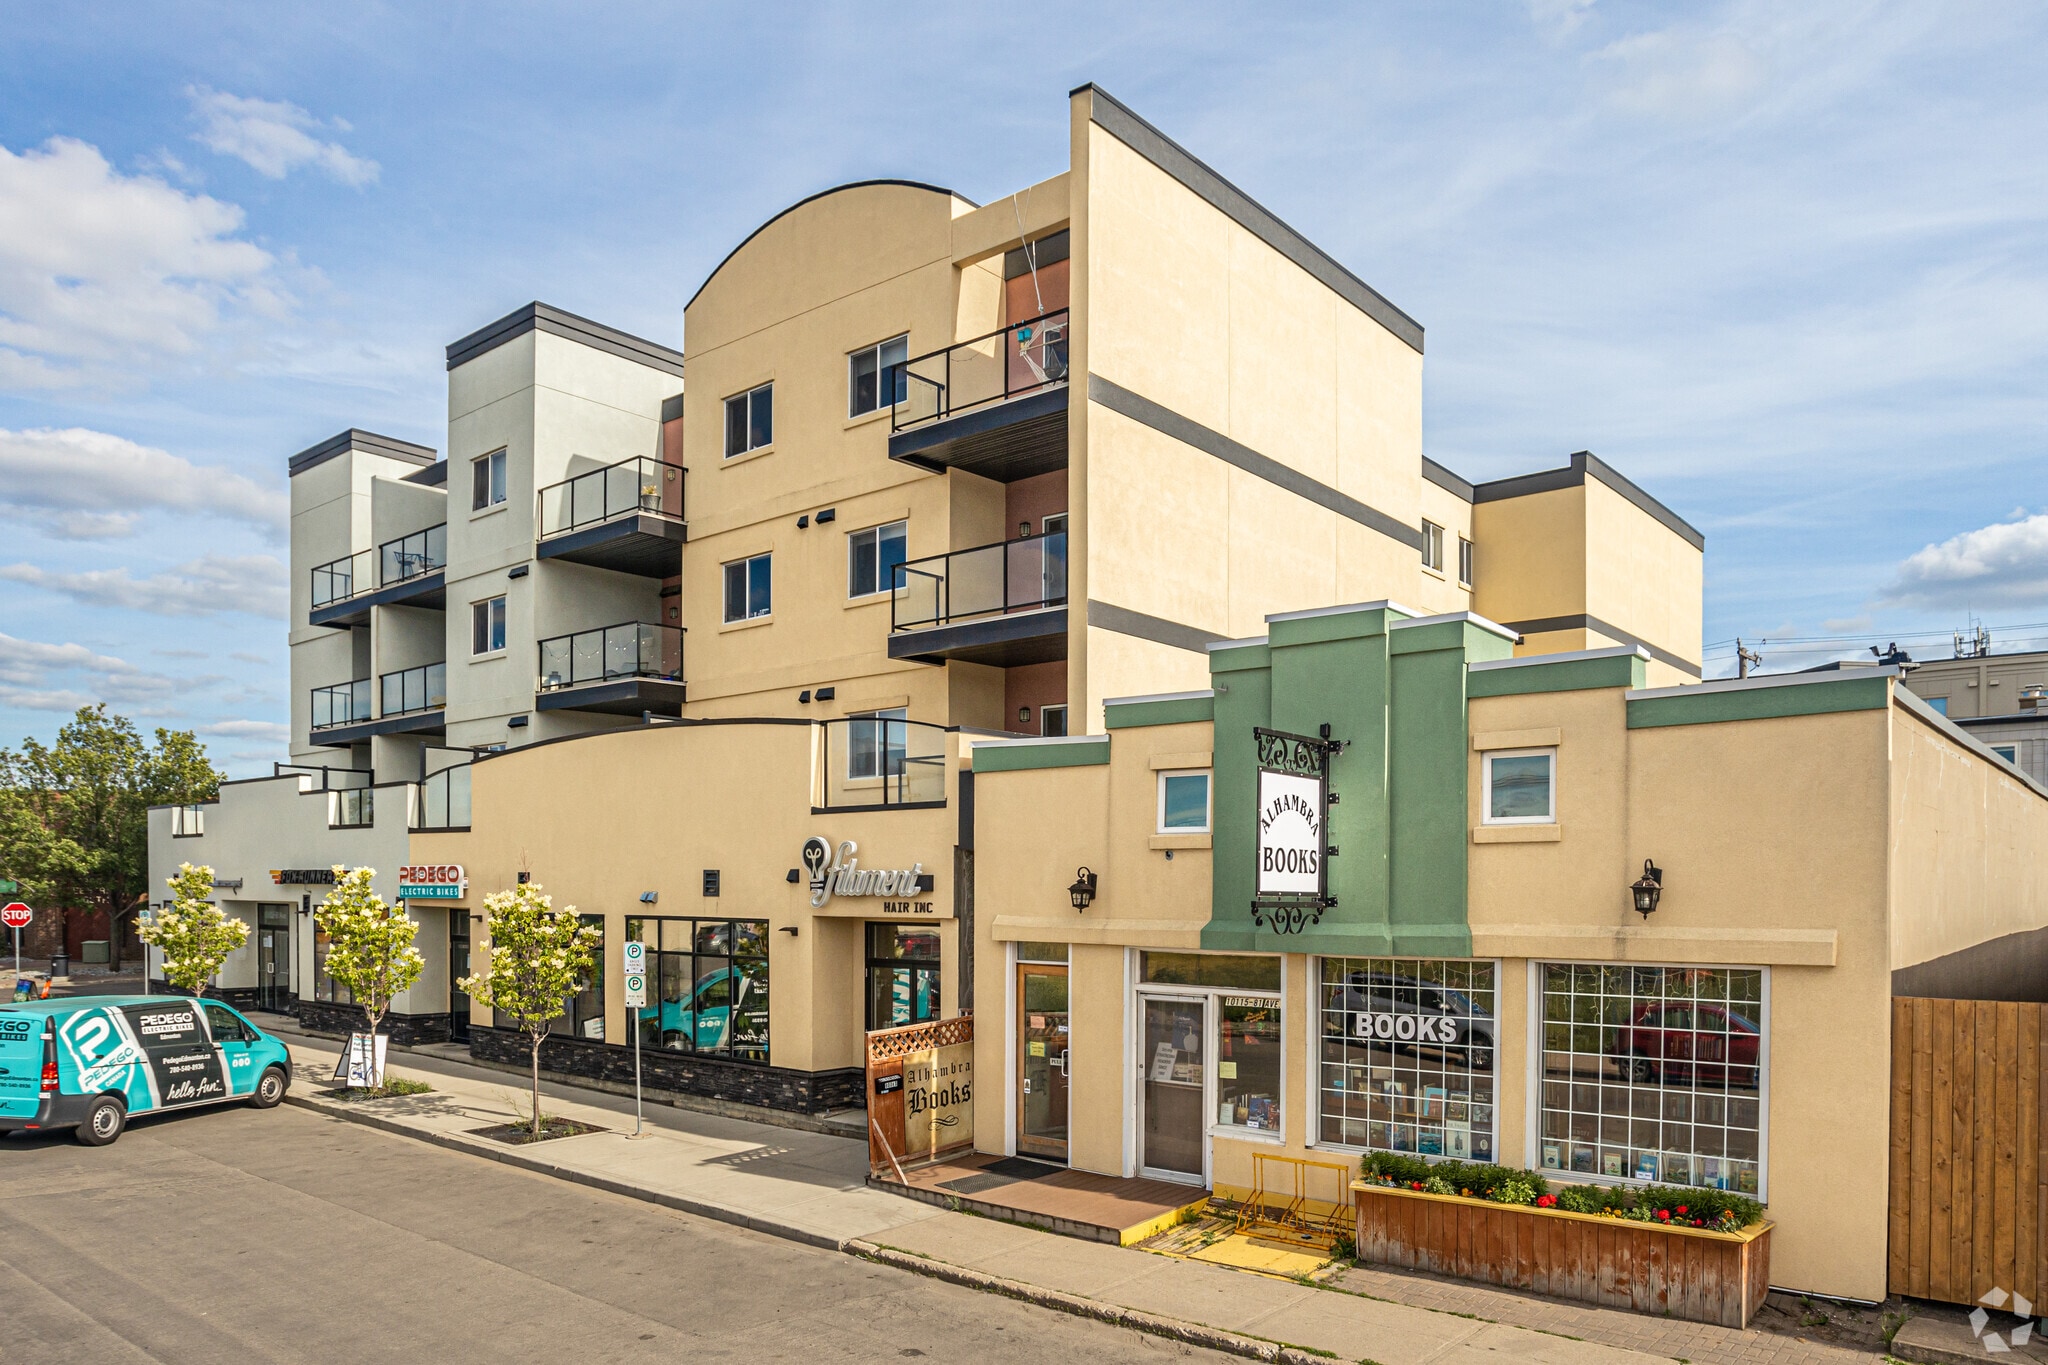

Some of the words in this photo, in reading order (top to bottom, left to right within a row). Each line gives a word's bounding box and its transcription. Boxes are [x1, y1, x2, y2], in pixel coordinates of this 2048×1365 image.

[1261, 794, 1319, 837] ALHAMBRA
[1263, 846, 1318, 874] BOOKS
[399, 866, 459, 883] PEDEGO
[400, 887, 434, 896] ELECTRIC
[436, 887, 458, 896] BIKES
[3, 909, 31, 921] STOP
[884, 902, 909, 913] HAIR
[913, 902, 933, 913] INC
[140, 1012, 193, 1027] PEDEGO
[1356, 1013, 1457, 1043] BOOKS
[143, 1026, 174, 1034] ELECTRIC
[84, 1047, 134, 1087] PEDEGO
[907, 1062, 971, 1084] Alhambra
[908, 1081, 972, 1120] Books
